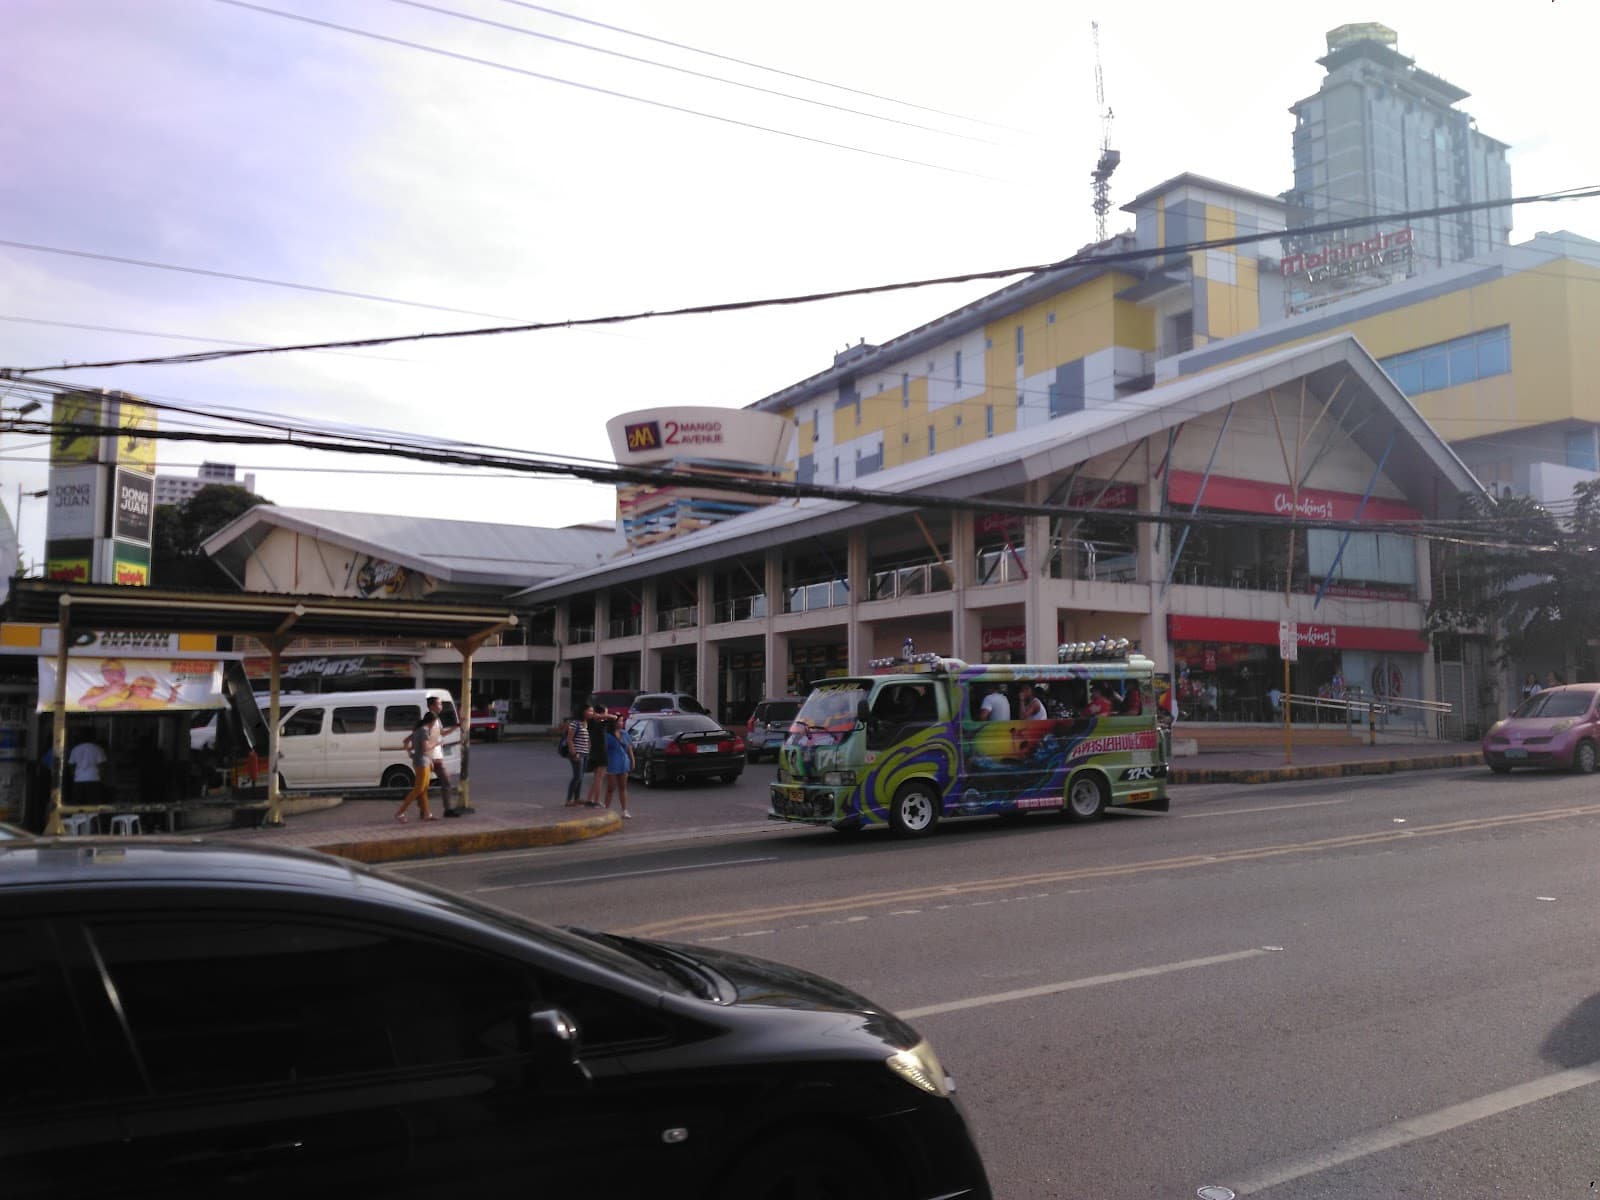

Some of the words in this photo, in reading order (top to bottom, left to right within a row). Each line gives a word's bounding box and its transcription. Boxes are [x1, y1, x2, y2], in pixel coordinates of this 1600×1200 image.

[665, 421, 680, 445] 2
[680, 423, 722, 432] MANGO
[681, 434, 723, 444] AVENUE
[55, 484, 90, 497] DONG
[121, 486, 149, 505] DONG
[54, 496, 90, 508] JUAN
[120, 501, 148, 515] JUAN
[101, 640, 169, 648] EXPRESS
